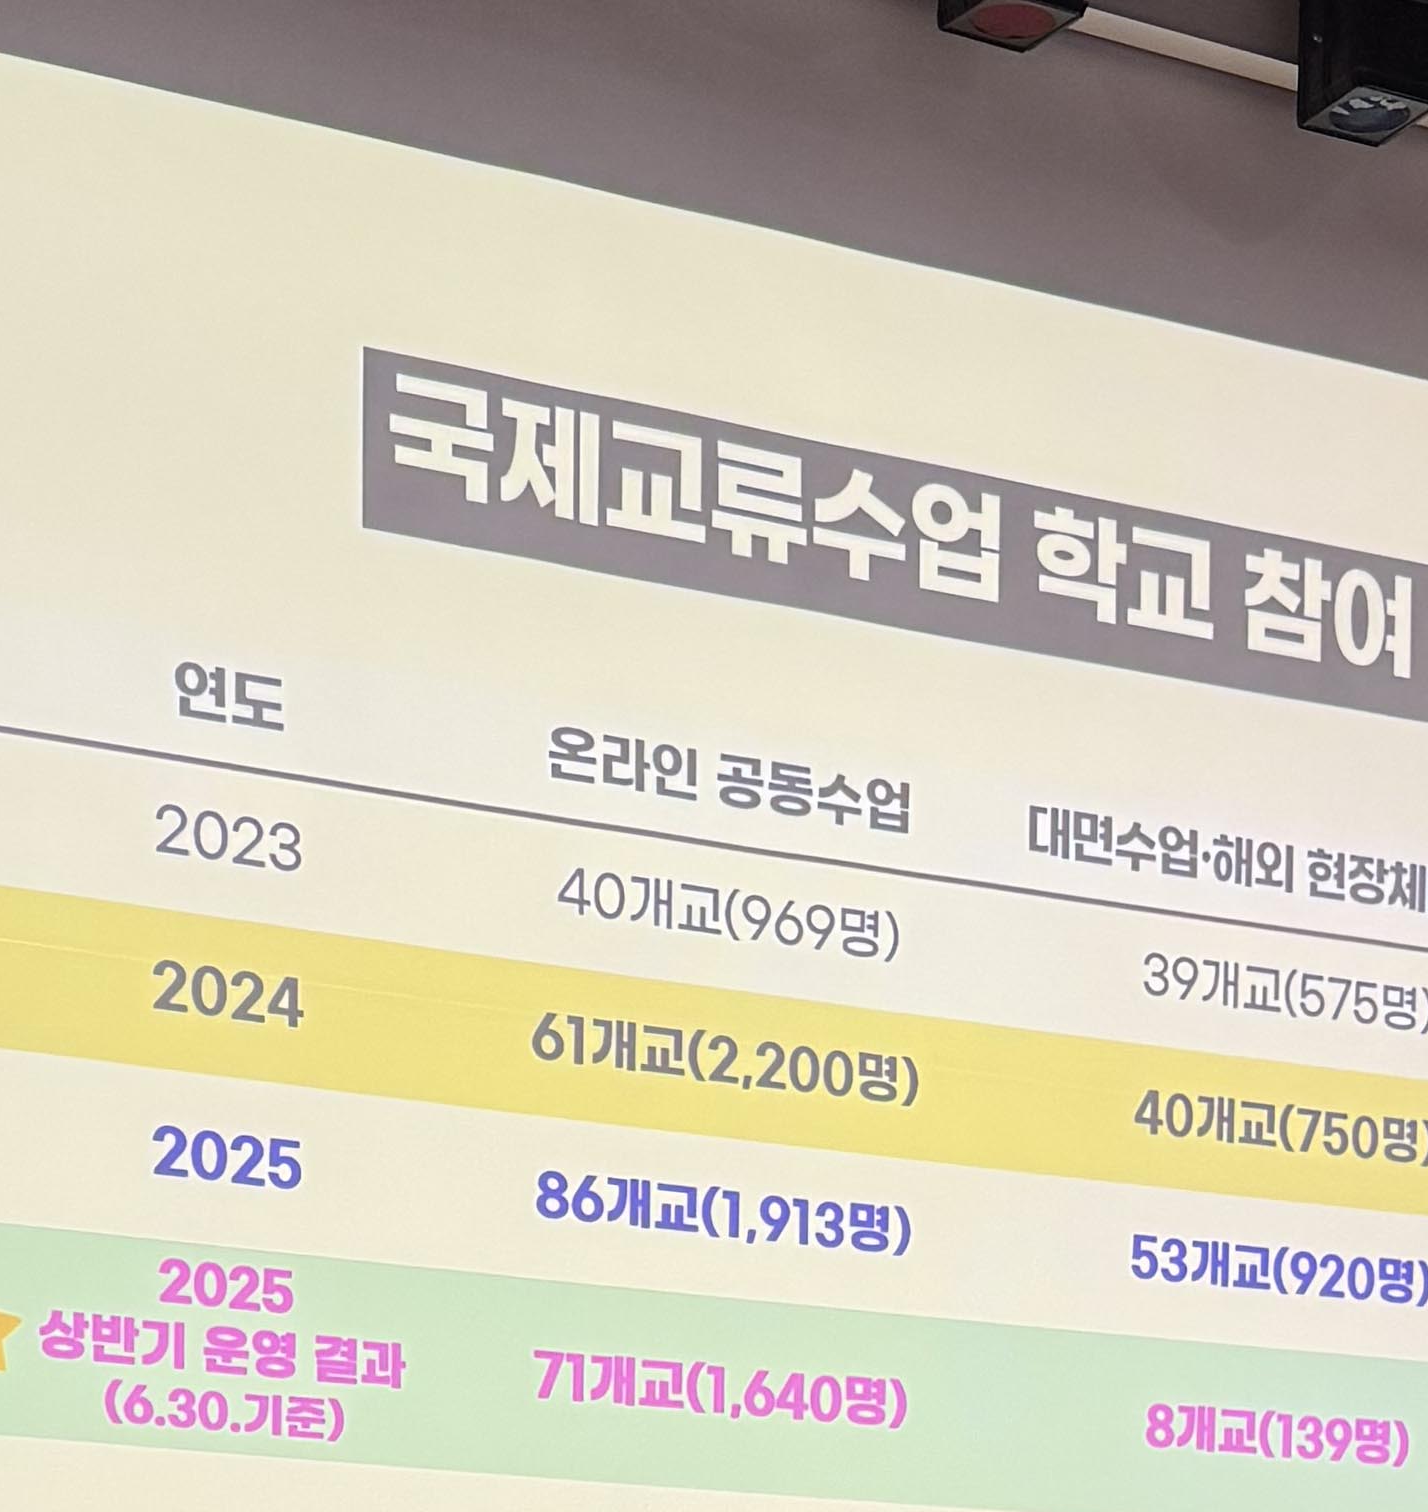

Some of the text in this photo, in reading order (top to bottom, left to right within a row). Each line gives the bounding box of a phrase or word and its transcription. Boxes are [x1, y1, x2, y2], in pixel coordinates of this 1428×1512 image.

[387, 372, 1002, 602] 국제교류수업
[1031, 506, 1215, 642] 학교
[1242, 548, 1411, 682] 참여
[173, 660, 286, 732] 연도
[546, 727, 913, 835] 온라인 공동수업
[154, 803, 304, 875] 2023
[555, 867, 903, 963] 40개교(969명)
[152, 959, 305, 1031] 2024
[529, 1011, 920, 1108] 61개교(2,200명)
[151, 1125, 304, 1192] 2025
[534, 1170, 914, 1257] 86개교(1,913명)
[156, 1257, 295, 1314] 2025
[38, 1310, 407, 1390] 상반기 운영 결과
[103, 1381, 346, 1445] (6.30.기준)
[531, 1347, 910, 1432] 71개교(1,640명)
[1144, 1403, 1411, 1468] 8개교(139명)
